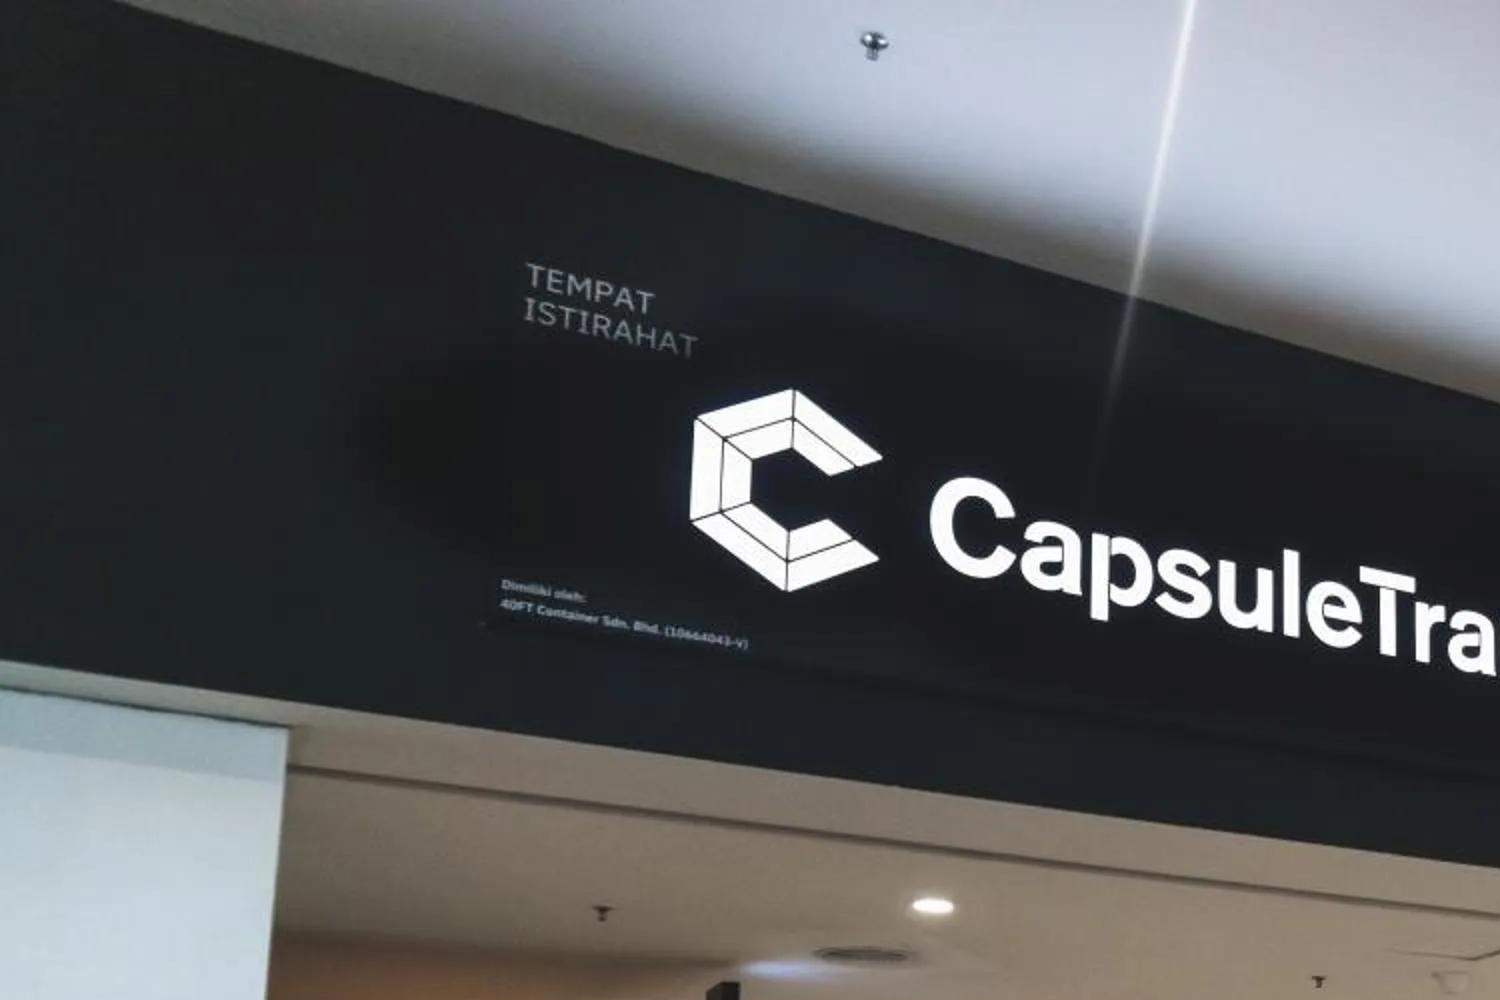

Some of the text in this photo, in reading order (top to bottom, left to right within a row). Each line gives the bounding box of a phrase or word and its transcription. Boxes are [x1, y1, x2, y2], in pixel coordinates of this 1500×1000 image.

[525, 262, 656, 315] TEMPAT
[524, 297, 699, 358] ISTIRAHAT
[501, 599, 533, 613] 40FT
[536, 604, 599, 624] Container
